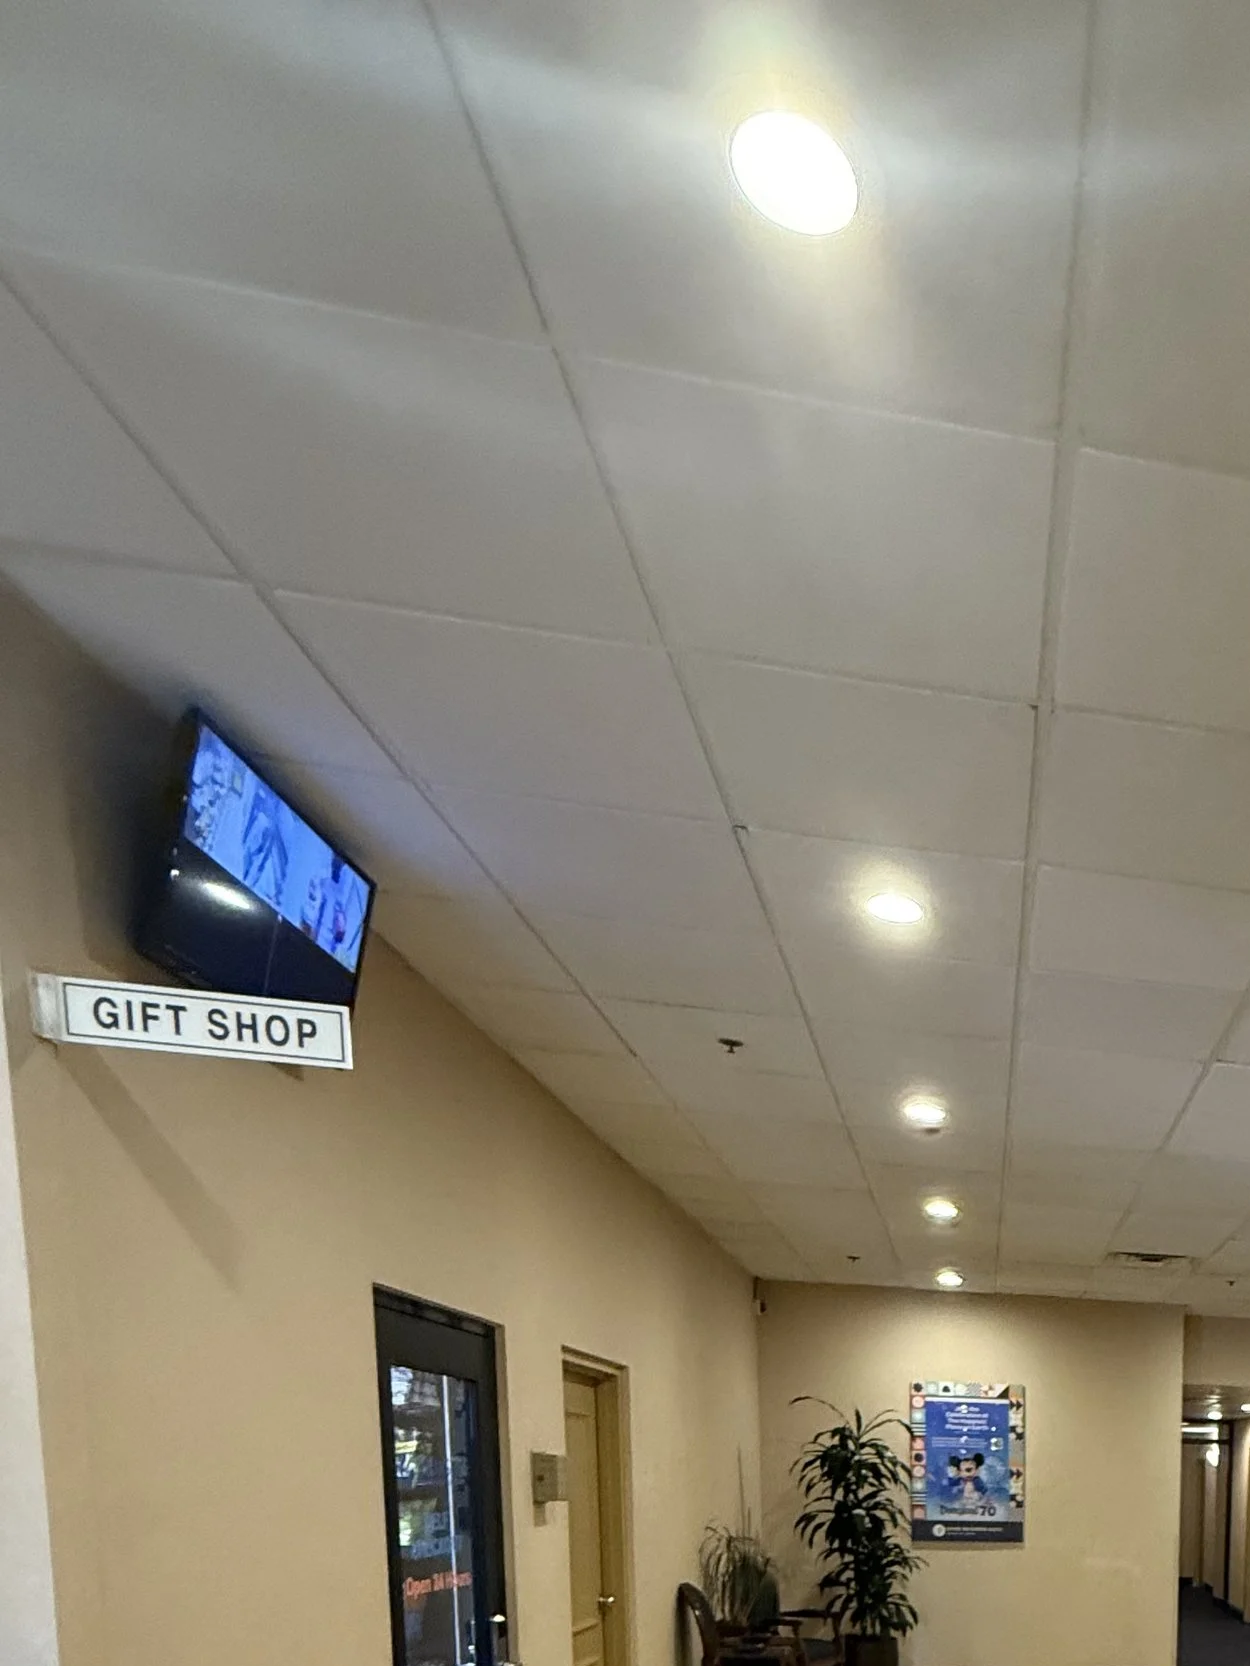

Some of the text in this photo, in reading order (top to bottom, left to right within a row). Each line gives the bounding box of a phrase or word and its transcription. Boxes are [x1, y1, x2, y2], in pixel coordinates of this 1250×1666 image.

[92, 996, 317, 1048] GIFT SHOP
[978, 1505, 997, 1517] 70
[402, 1577, 432, 1600] Open
